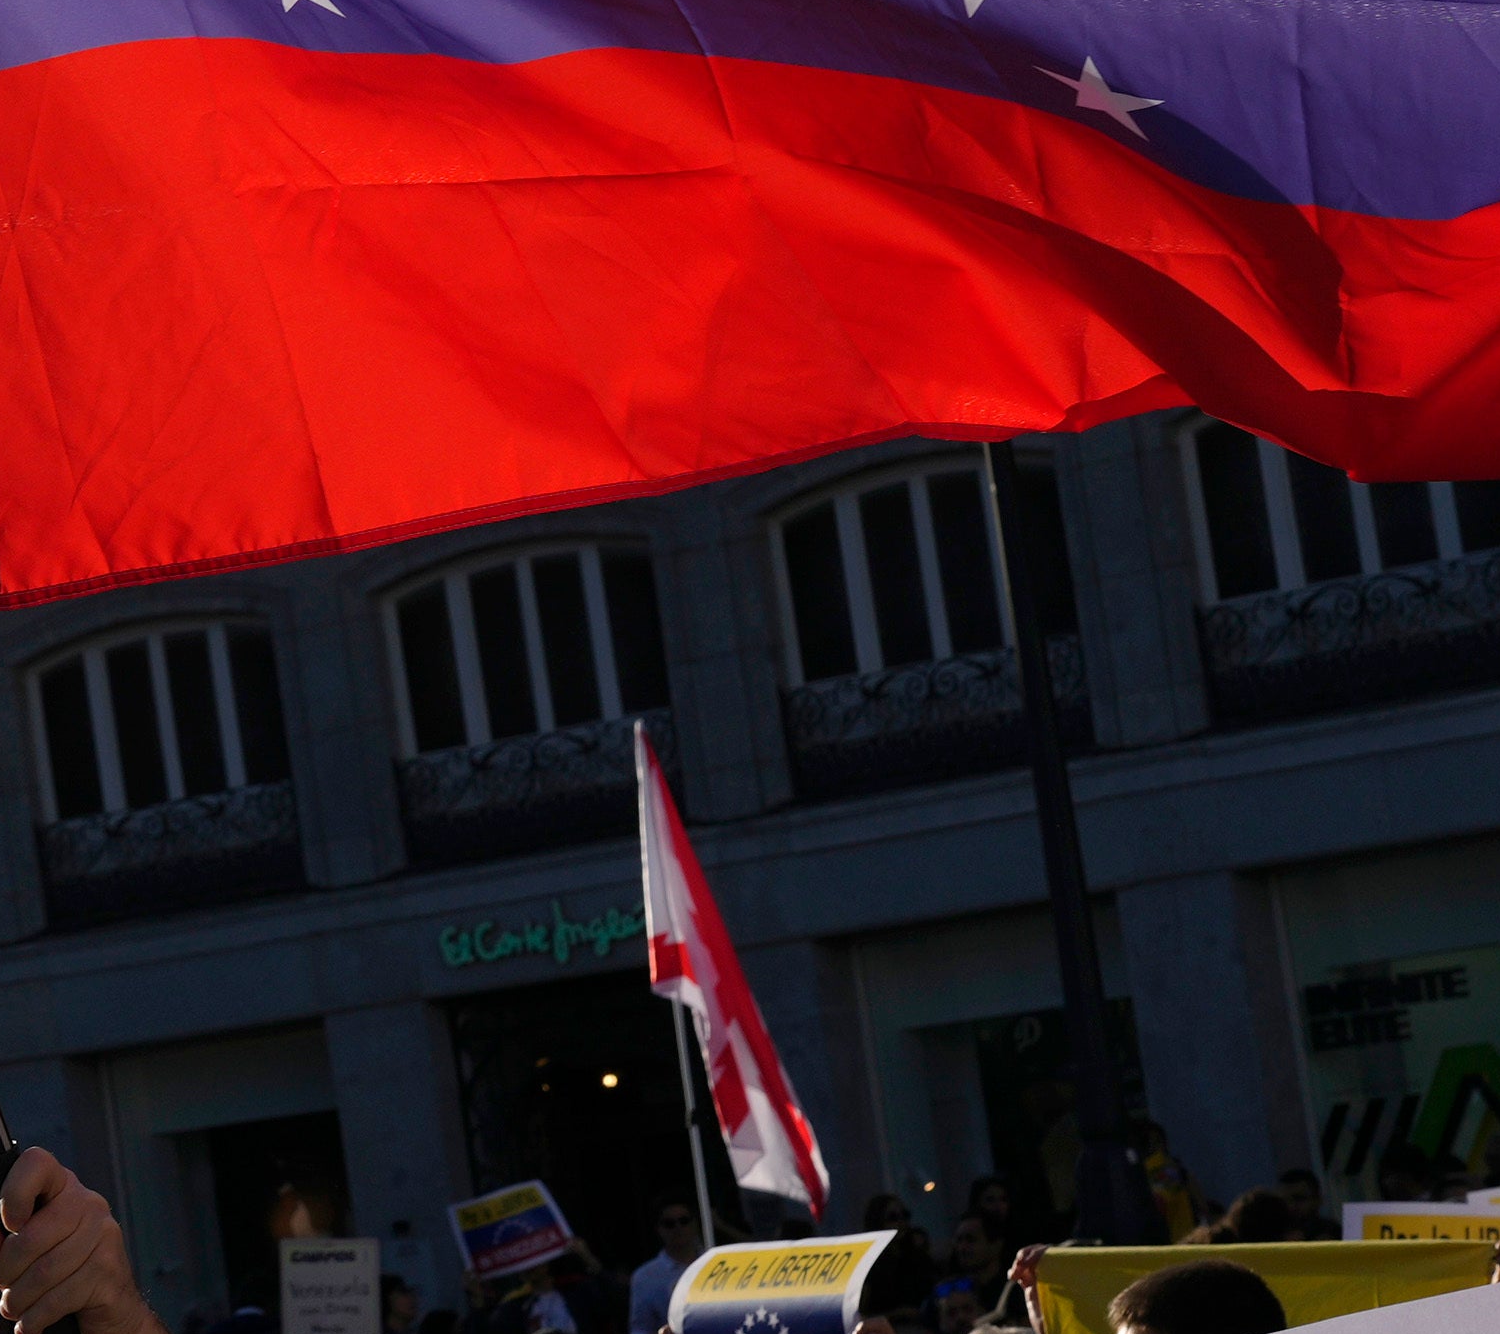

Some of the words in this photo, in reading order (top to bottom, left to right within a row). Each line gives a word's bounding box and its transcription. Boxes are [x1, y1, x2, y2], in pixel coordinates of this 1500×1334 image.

[700, 1259, 738, 1293] Por
[739, 1257, 759, 1291] la
[757, 1251, 854, 1289] LIBERTAD
